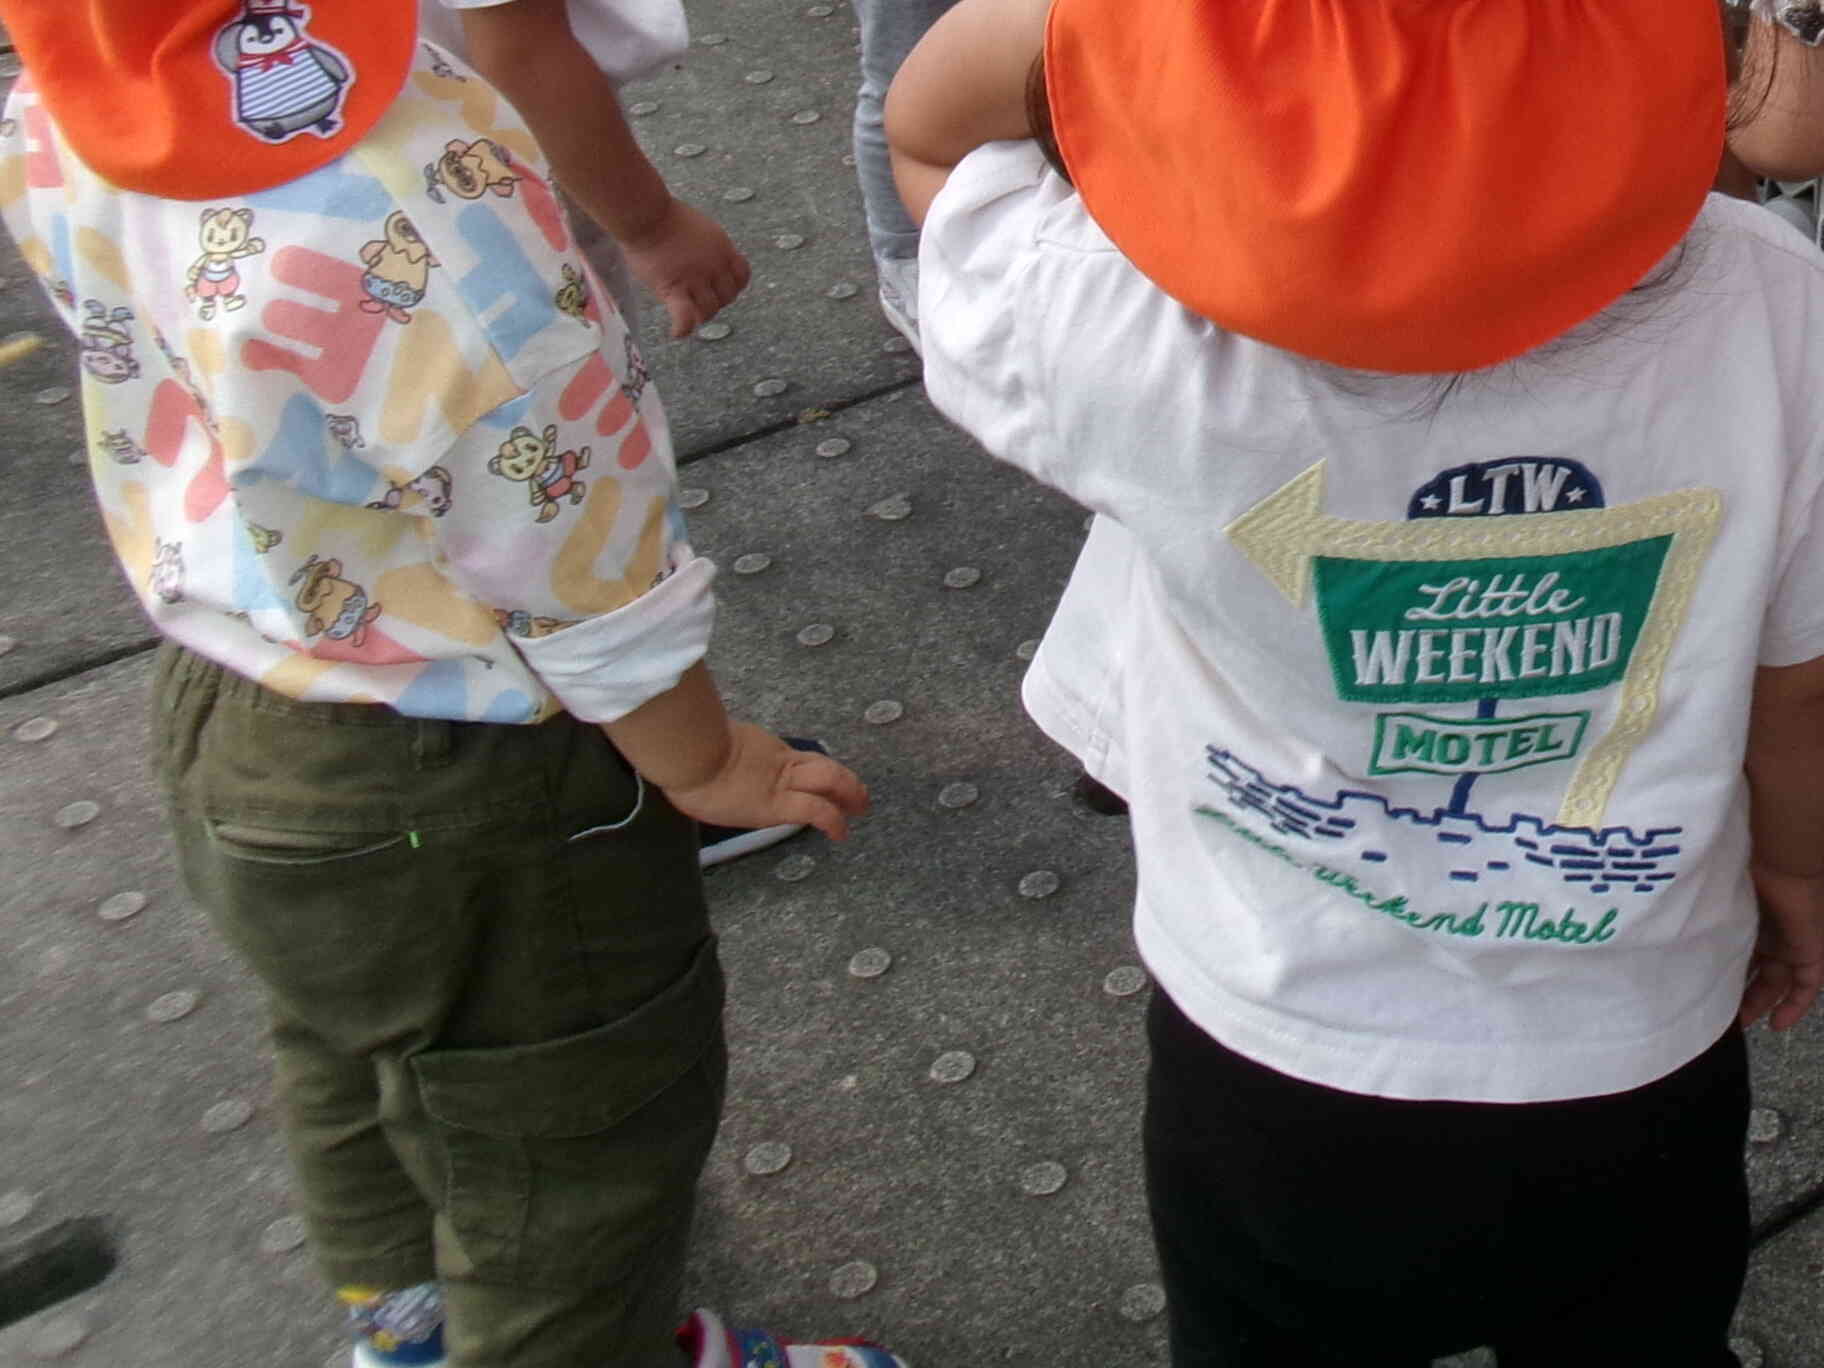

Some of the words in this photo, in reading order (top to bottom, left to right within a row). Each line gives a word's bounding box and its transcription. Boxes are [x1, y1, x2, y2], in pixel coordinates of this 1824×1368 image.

[1448, 463, 1571, 515] LTW
[1405, 571, 1585, 621] Little
[1349, 612, 1622, 685] WEEKEND
[1392, 724, 1564, 766] MOTEL
[1496, 900, 1619, 944] Motel
